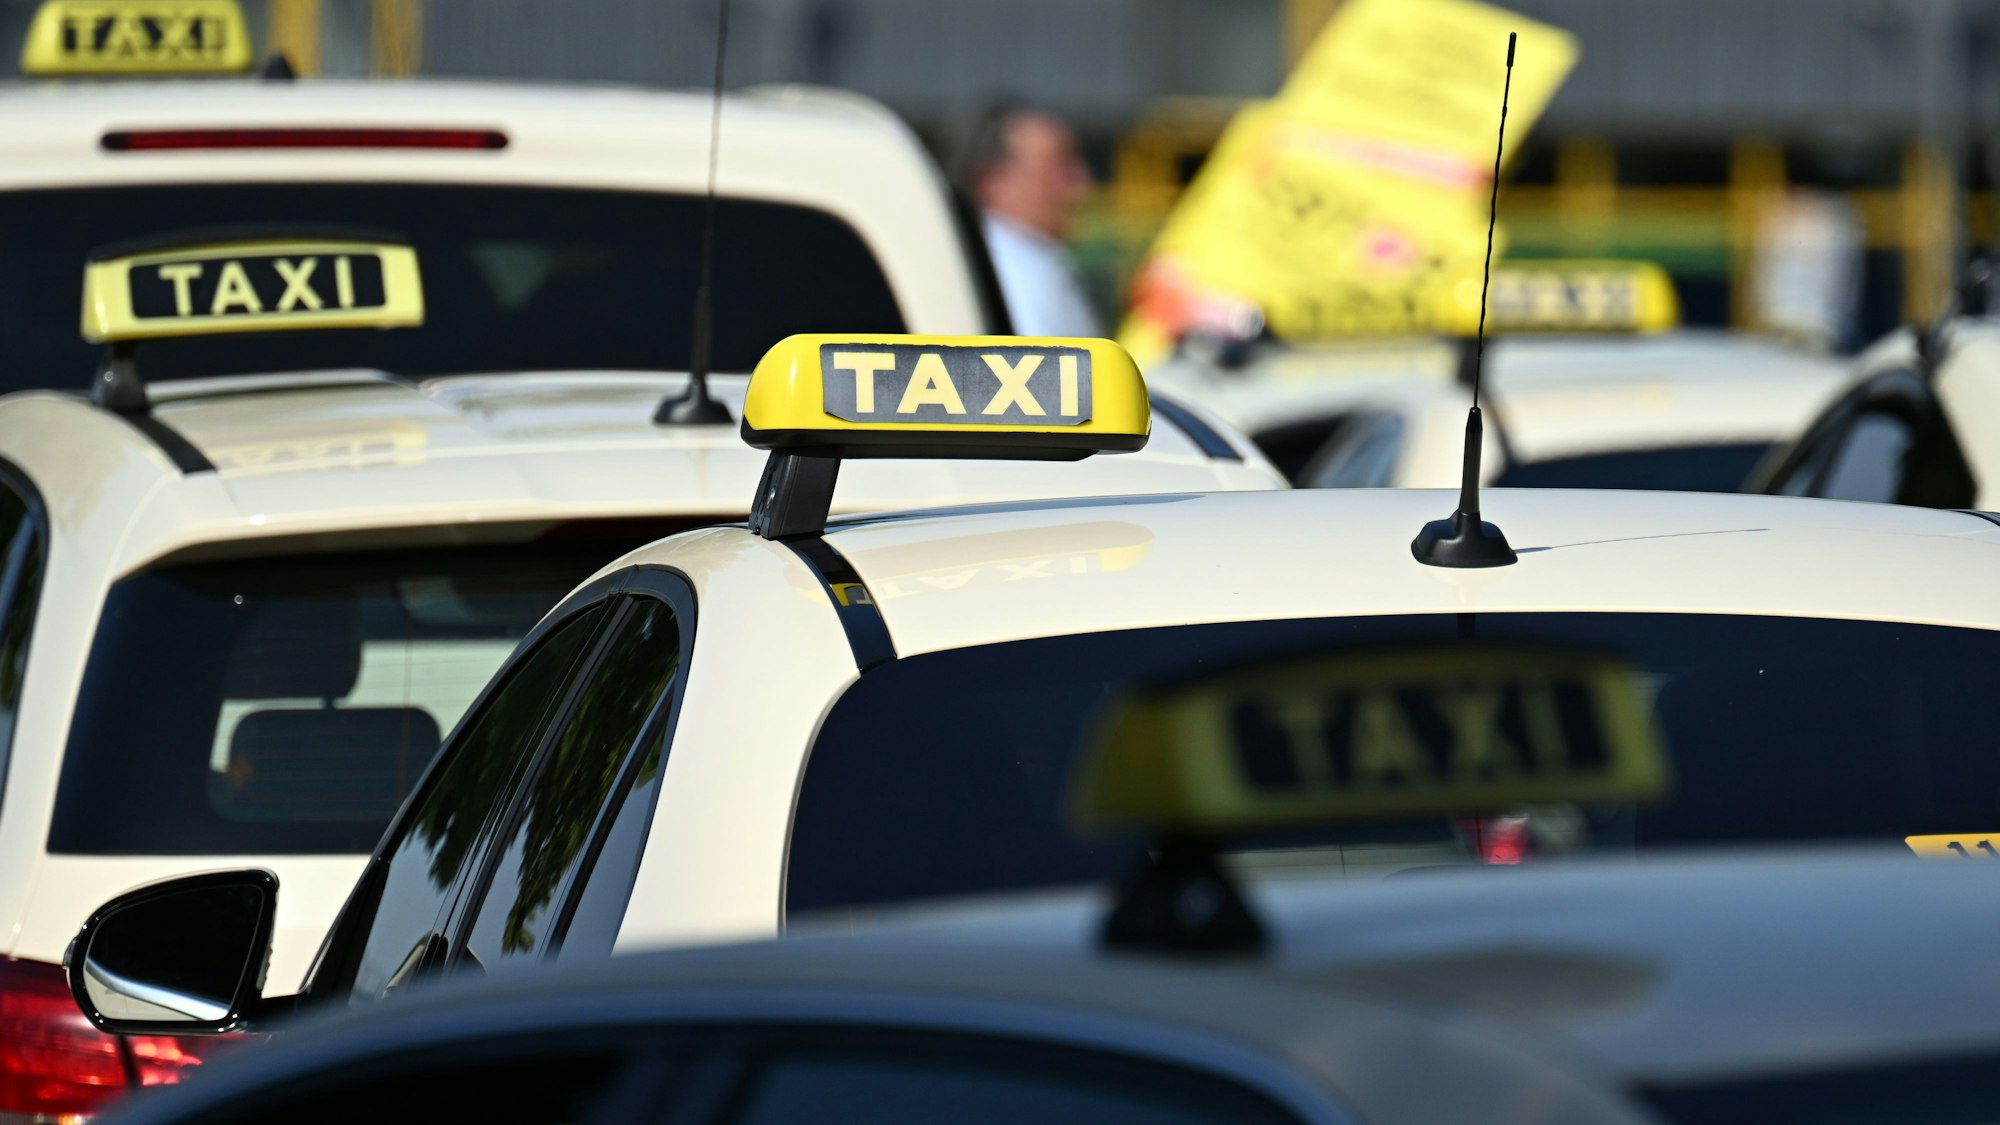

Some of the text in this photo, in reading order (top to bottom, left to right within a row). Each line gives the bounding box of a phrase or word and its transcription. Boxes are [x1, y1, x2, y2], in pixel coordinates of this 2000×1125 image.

[62, 16, 222, 58] TAXI
[158, 257, 355, 317] TAXI
[833, 352, 1079, 417] TAXI
[1262, 678, 1566, 795] TAXI
